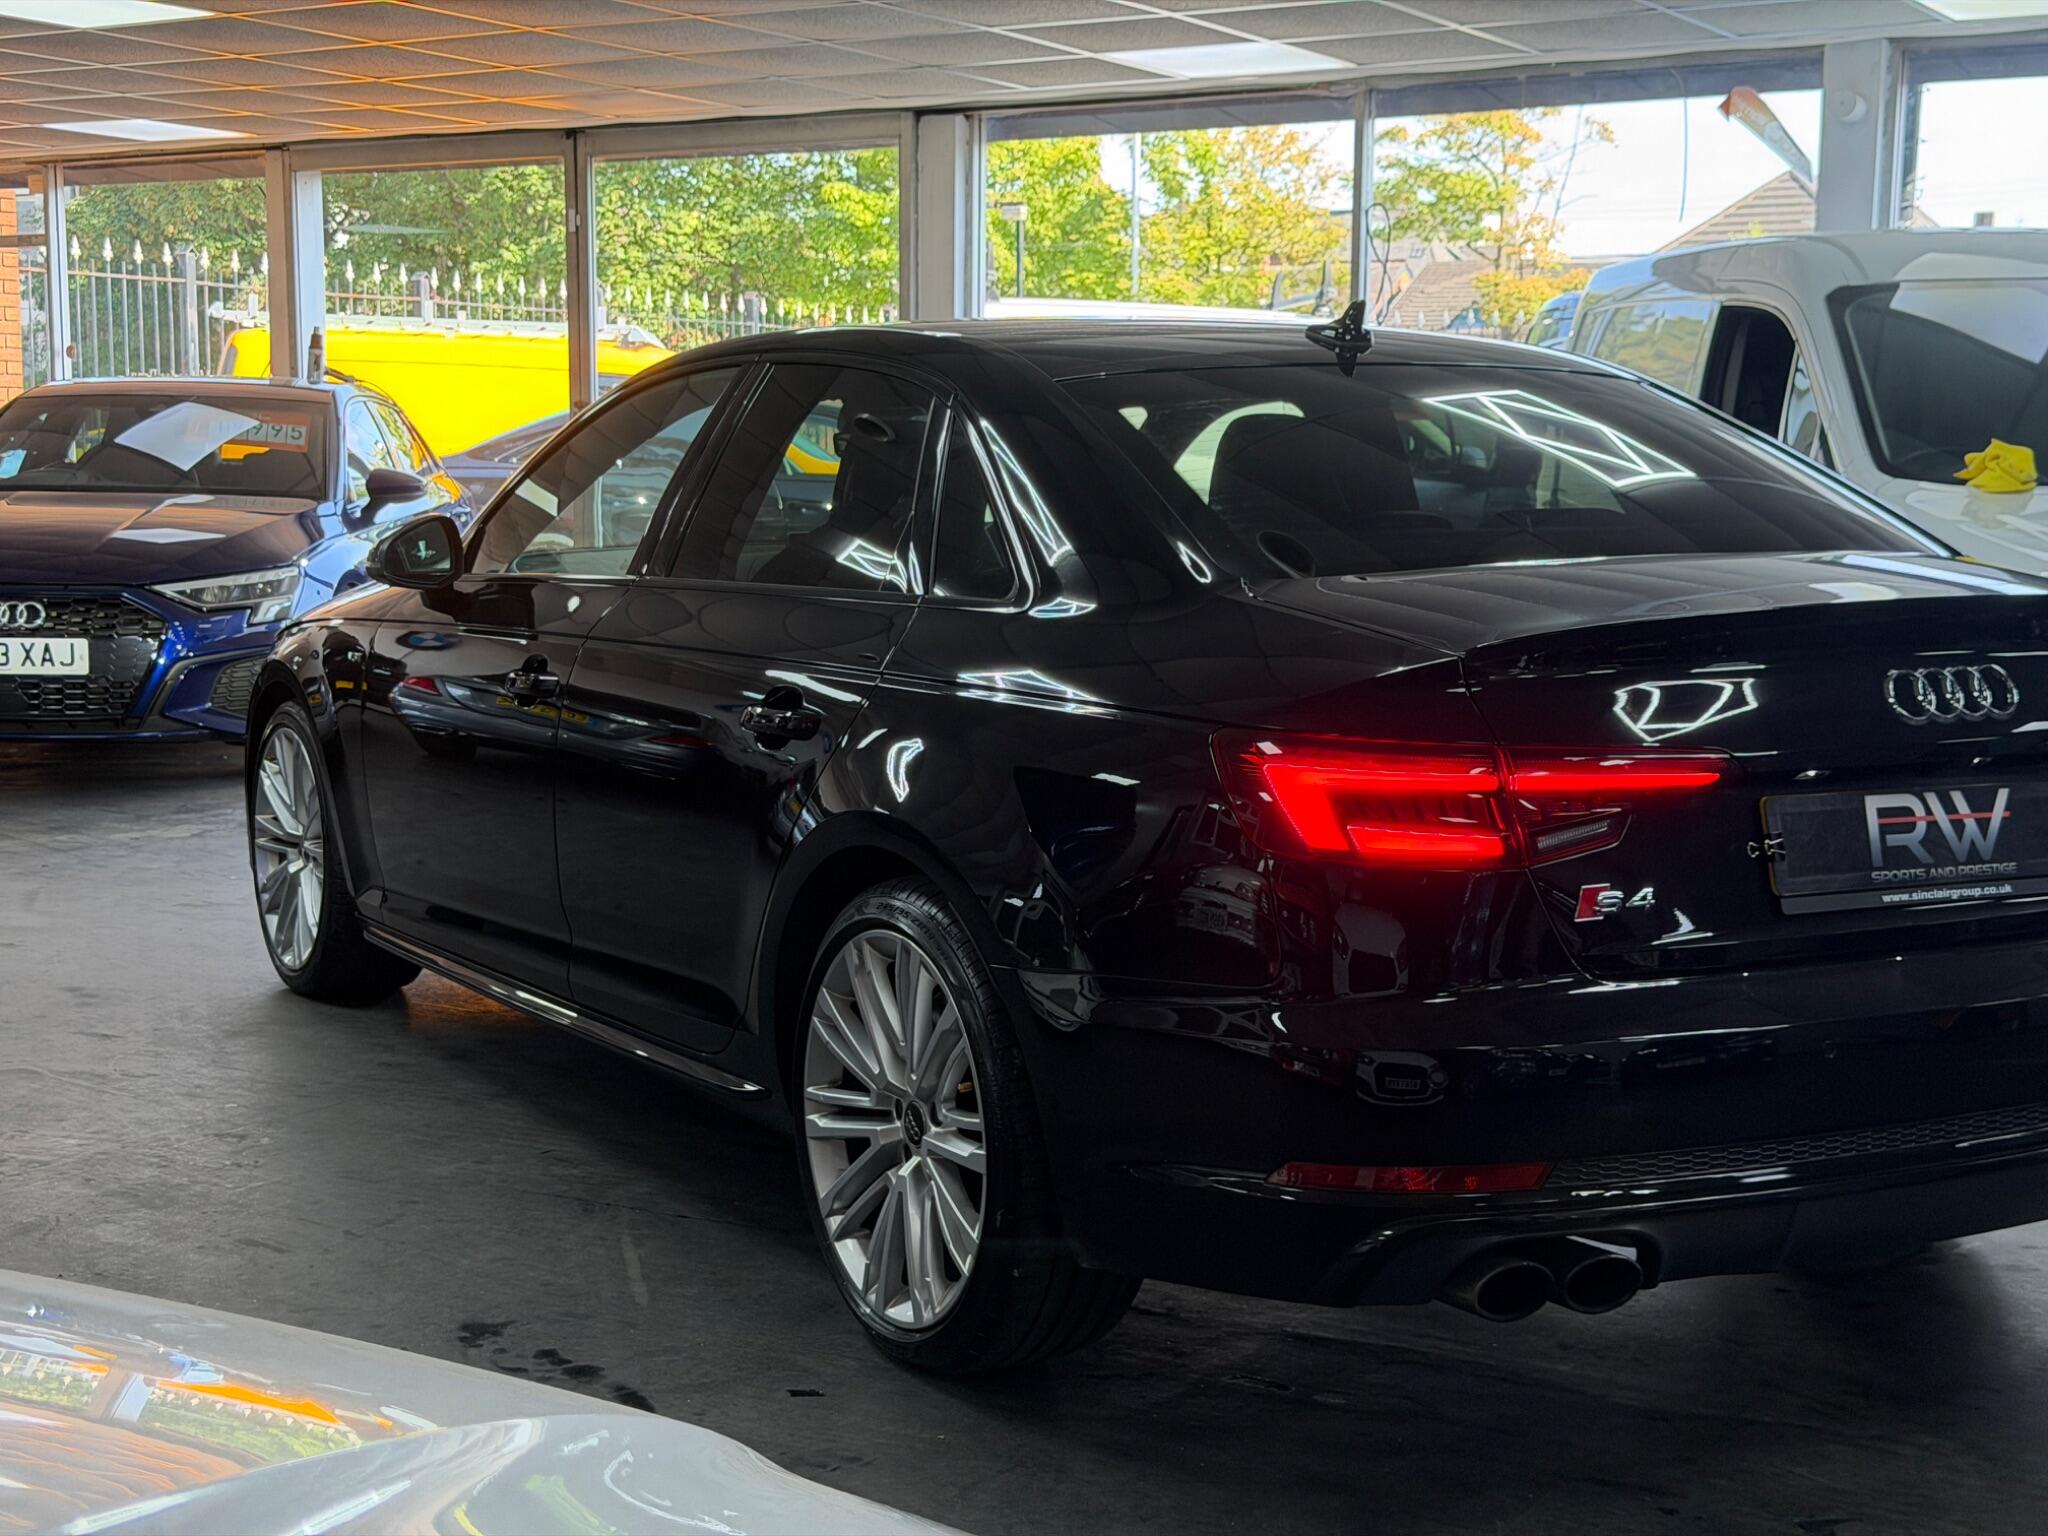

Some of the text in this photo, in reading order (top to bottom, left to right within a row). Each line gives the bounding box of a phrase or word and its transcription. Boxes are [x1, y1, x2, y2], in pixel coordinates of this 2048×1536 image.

[20, 642, 75, 667] XAJ
[1864, 787, 2011, 867] RW
[1871, 862, 2019, 883] SPORTS AND PRESTIGE
[1592, 886, 1656, 913] S4
[1881, 884, 2012, 903] www.sinclairgroup.co.uk
